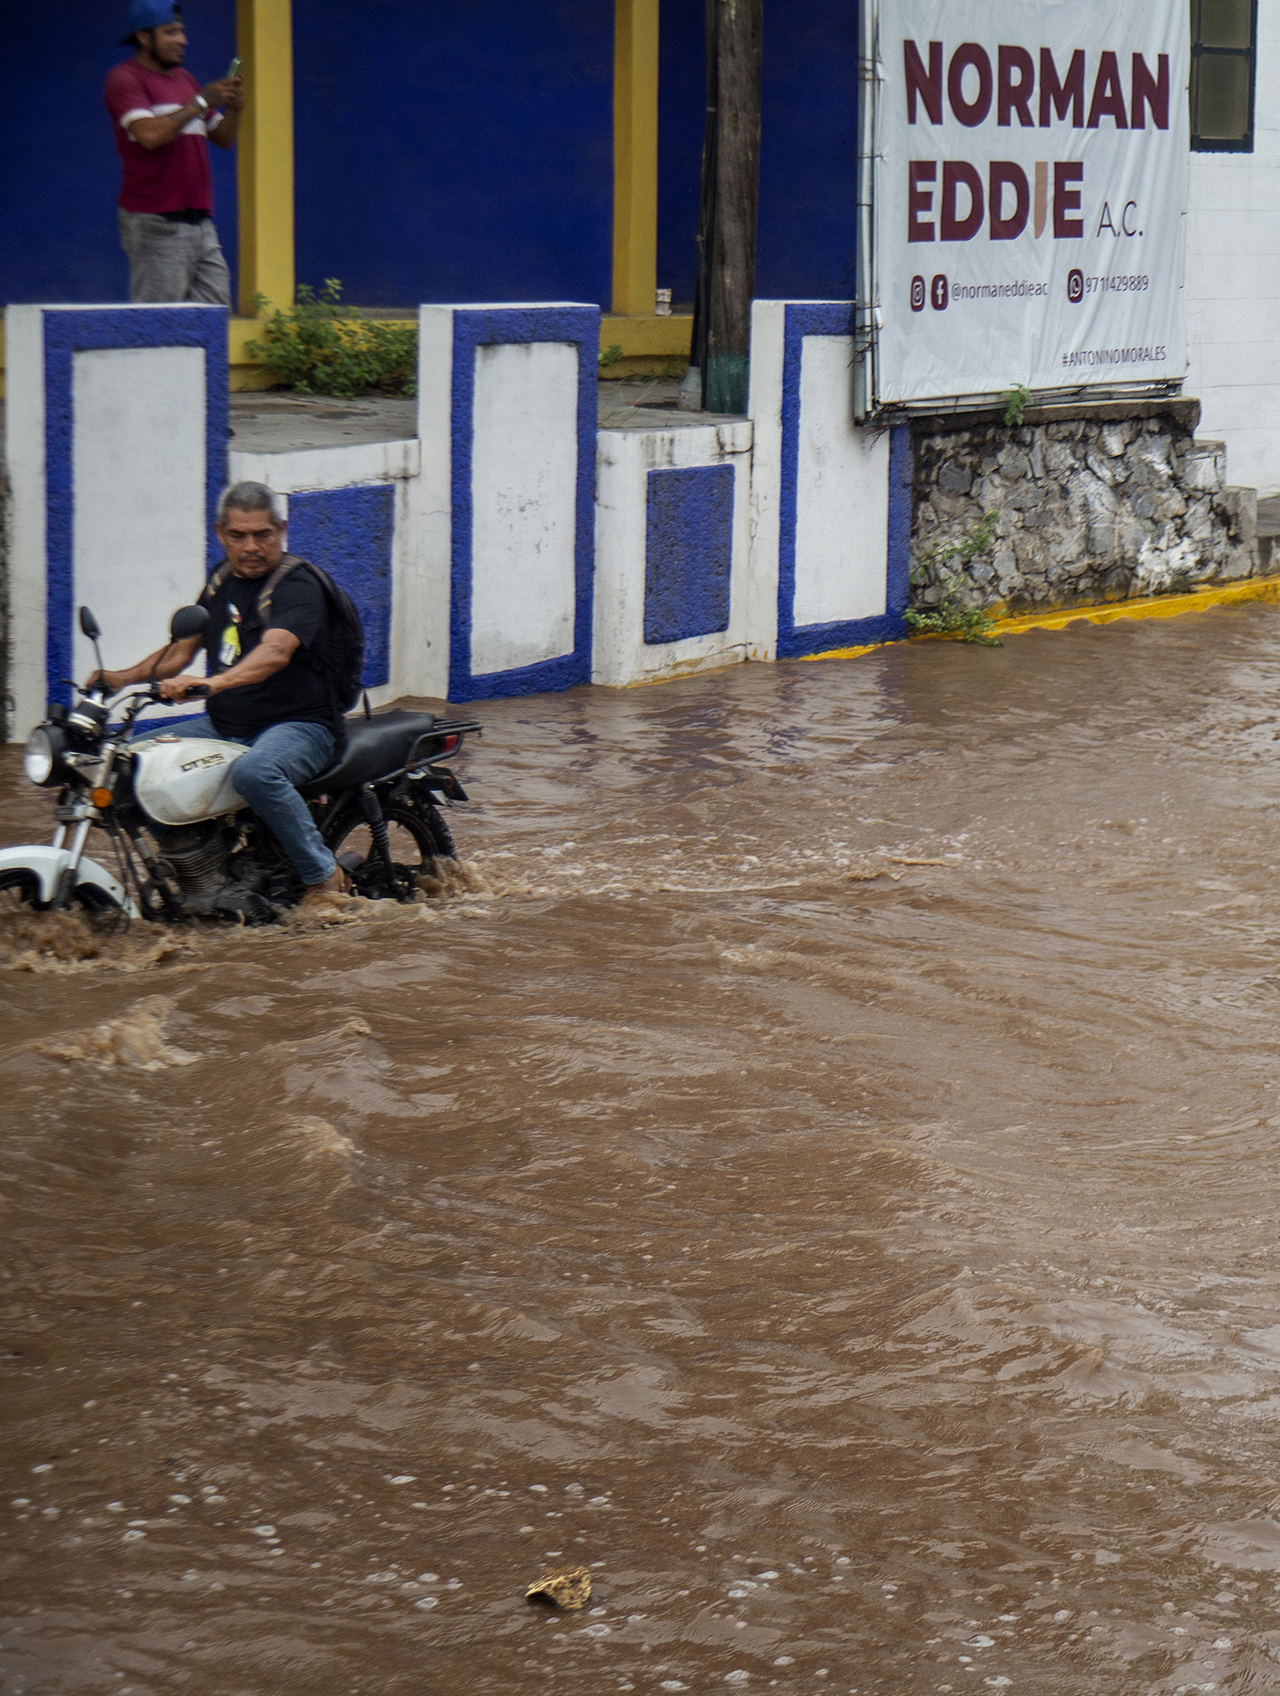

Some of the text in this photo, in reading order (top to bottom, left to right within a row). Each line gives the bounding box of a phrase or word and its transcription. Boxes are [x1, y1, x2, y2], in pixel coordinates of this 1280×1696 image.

[903, 39, 1170, 130] NORMAN
[908, 160, 1144, 243] EDDIE A.C.
[951, 279, 1049, 301] @normaneddieac
[1062, 346, 1167, 368] #ANTONINOMORALES
